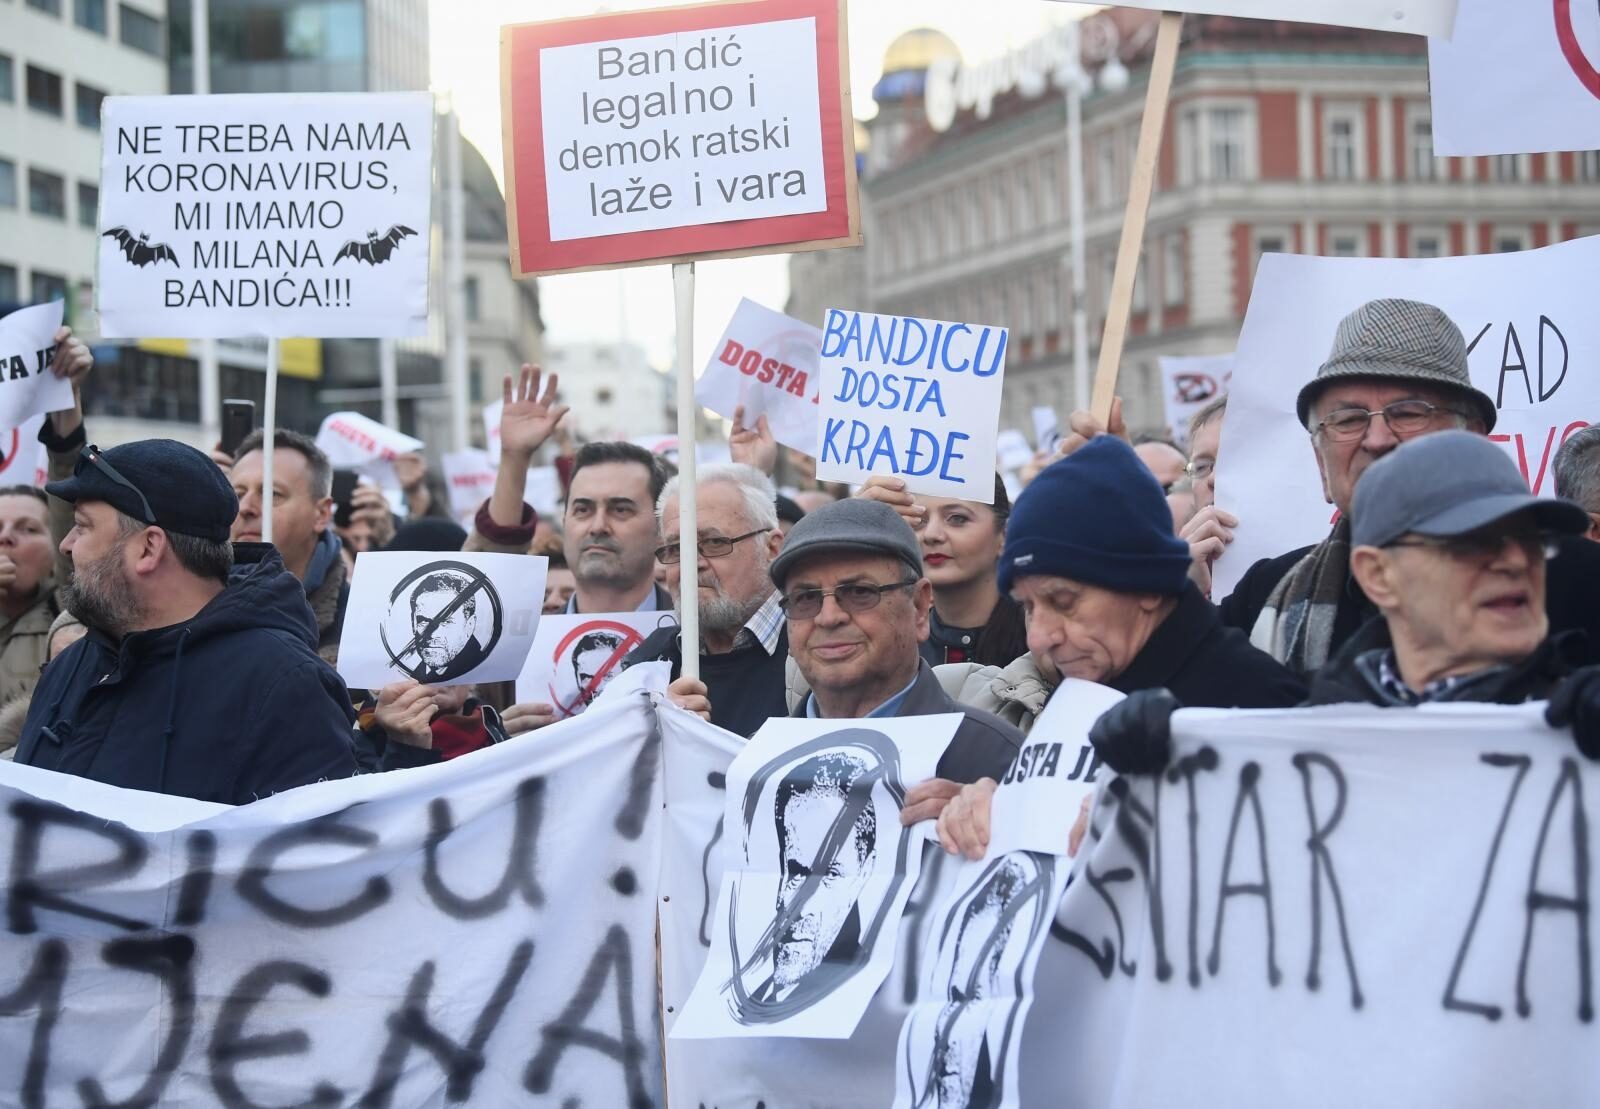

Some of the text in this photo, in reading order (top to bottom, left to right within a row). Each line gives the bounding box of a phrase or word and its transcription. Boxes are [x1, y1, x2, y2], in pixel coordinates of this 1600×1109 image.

[582, 73, 757, 130] legalno i
[117, 122, 411, 155] NE TREBA NAMA
[125, 160, 398, 194] KORONAVIRUS,
[589, 169, 807, 217] laže i vara
[174, 200, 344, 231] MI IMAMO
[193, 239, 324, 270] MILANA
[164, 271, 351, 308] BANDIĆA!!!
[719, 339, 809, 398] DOSTA
[833, 366, 947, 418] DOSTA
[820, 417, 970, 484] KRAĐE
[1442, 751, 1594, 1025] ZA
